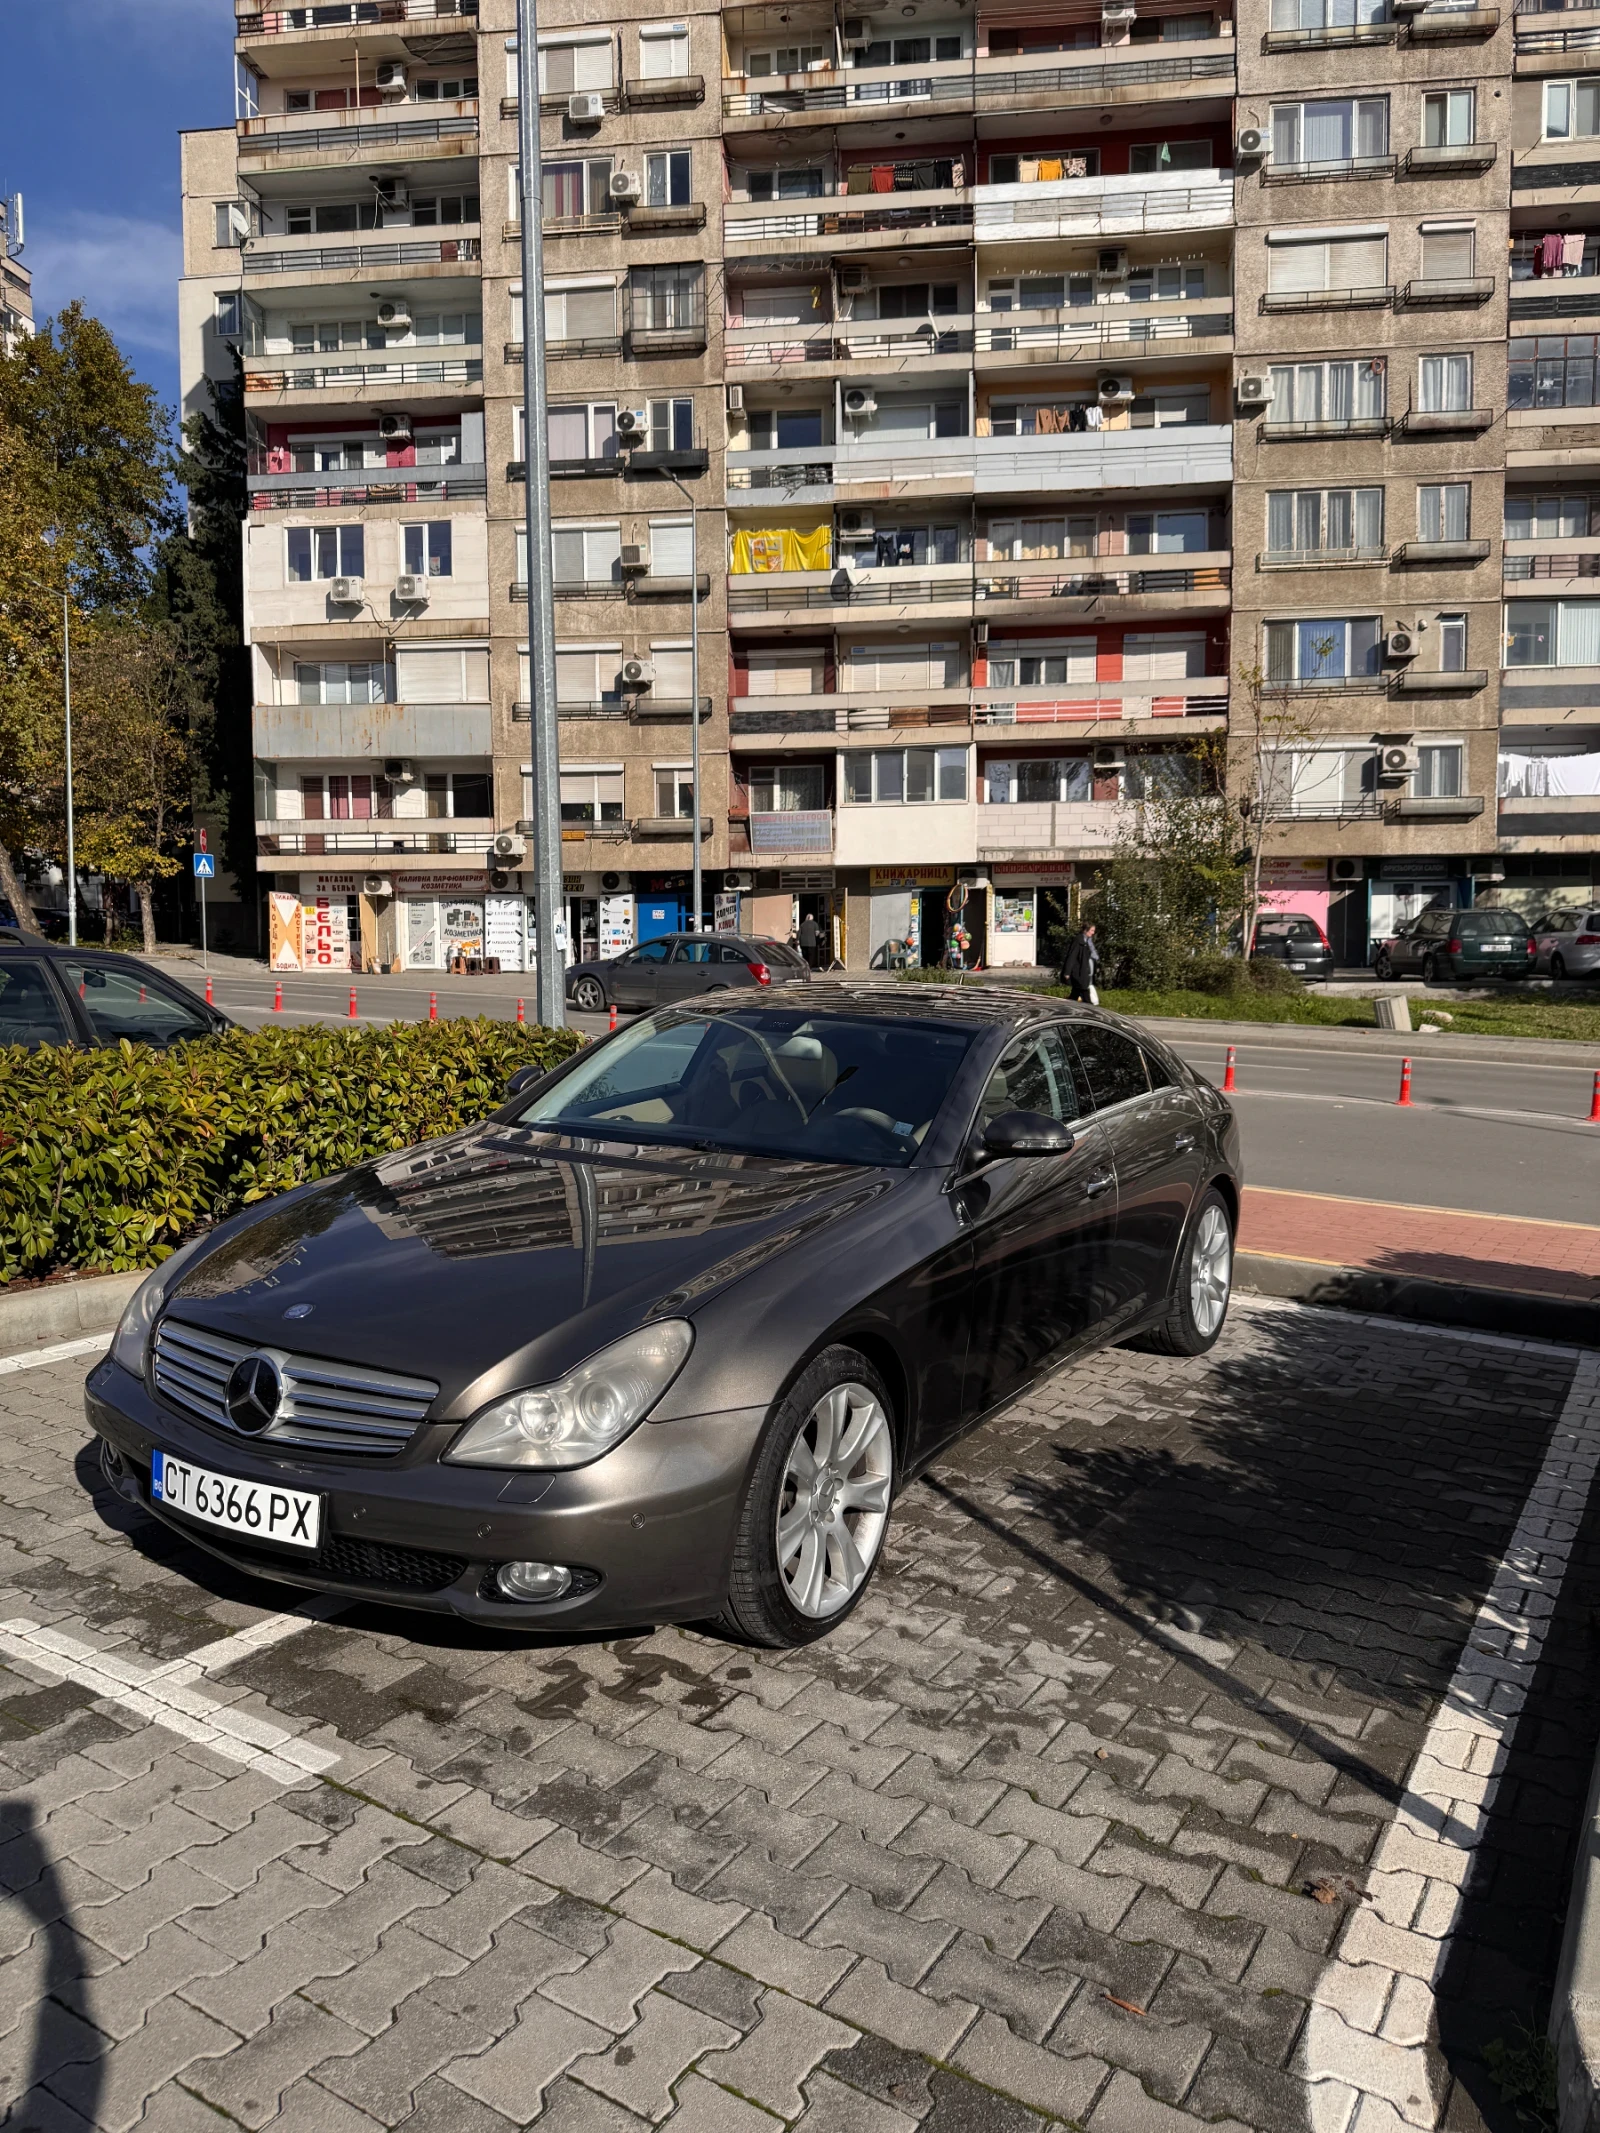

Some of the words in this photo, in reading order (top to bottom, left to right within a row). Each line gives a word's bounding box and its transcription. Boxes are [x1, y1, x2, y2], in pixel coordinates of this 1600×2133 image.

[995, 863, 1071, 873] КНИЖАРНИЦА
[1424, 864, 1445, 872] САЛОН
[398, 875, 431, 883] НАЛИВНА
[432, 874, 484, 882] ПАРФЮМЕРИЯ
[875, 867, 948, 880] КНИЖАРНИЦА
[318, 875, 354, 883] МАГАЗИН
[421, 882, 462, 890] КОЗМЕТИКА
[316, 897, 332, 965] БЕЛЬО
[444, 927, 484, 938] КОЗМЕТИКА
[276, 962, 299, 970] БОДИТА
[154, 1479, 163, 1493] BG
[165, 1461, 191, 1506] CT
[196, 1475, 262, 1528] 6366
[268, 1492, 312, 1540] PX
